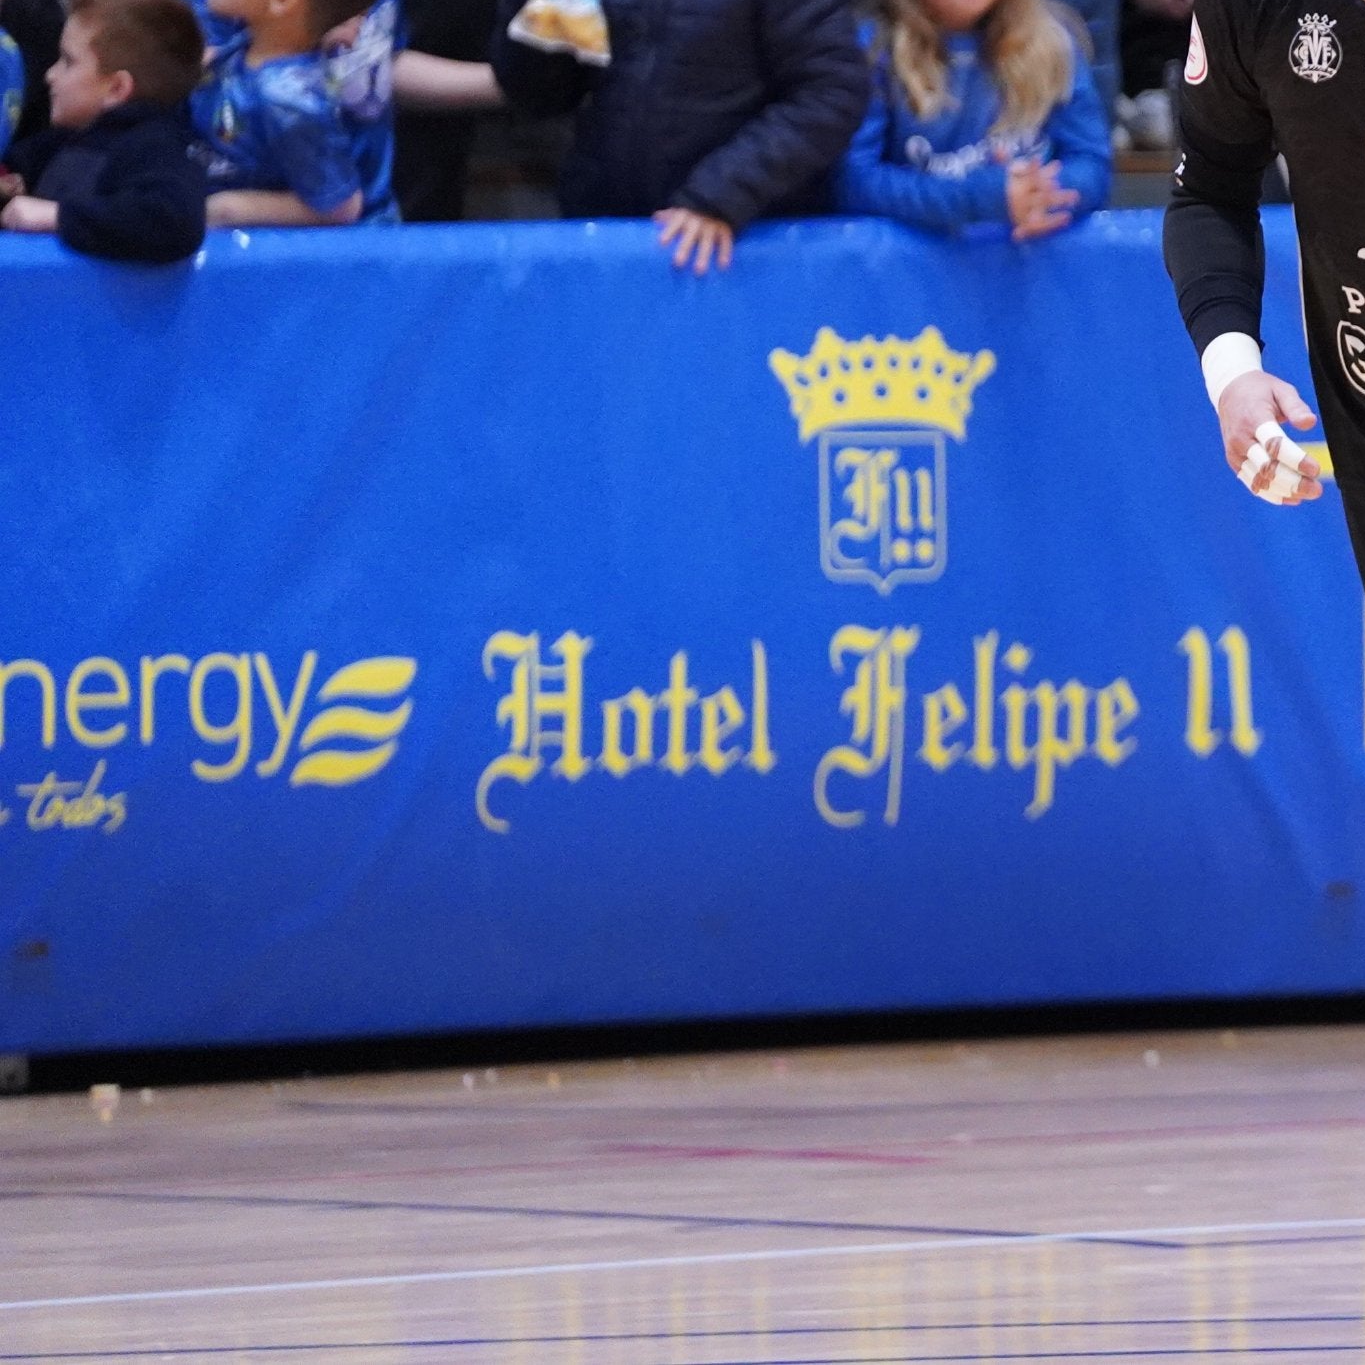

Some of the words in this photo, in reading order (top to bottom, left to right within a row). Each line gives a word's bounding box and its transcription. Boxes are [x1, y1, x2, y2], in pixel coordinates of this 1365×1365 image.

[0, 652, 318, 782] nergy
[474, 630, 778, 835] Hotel
[814, 624, 1141, 827] Felipe
